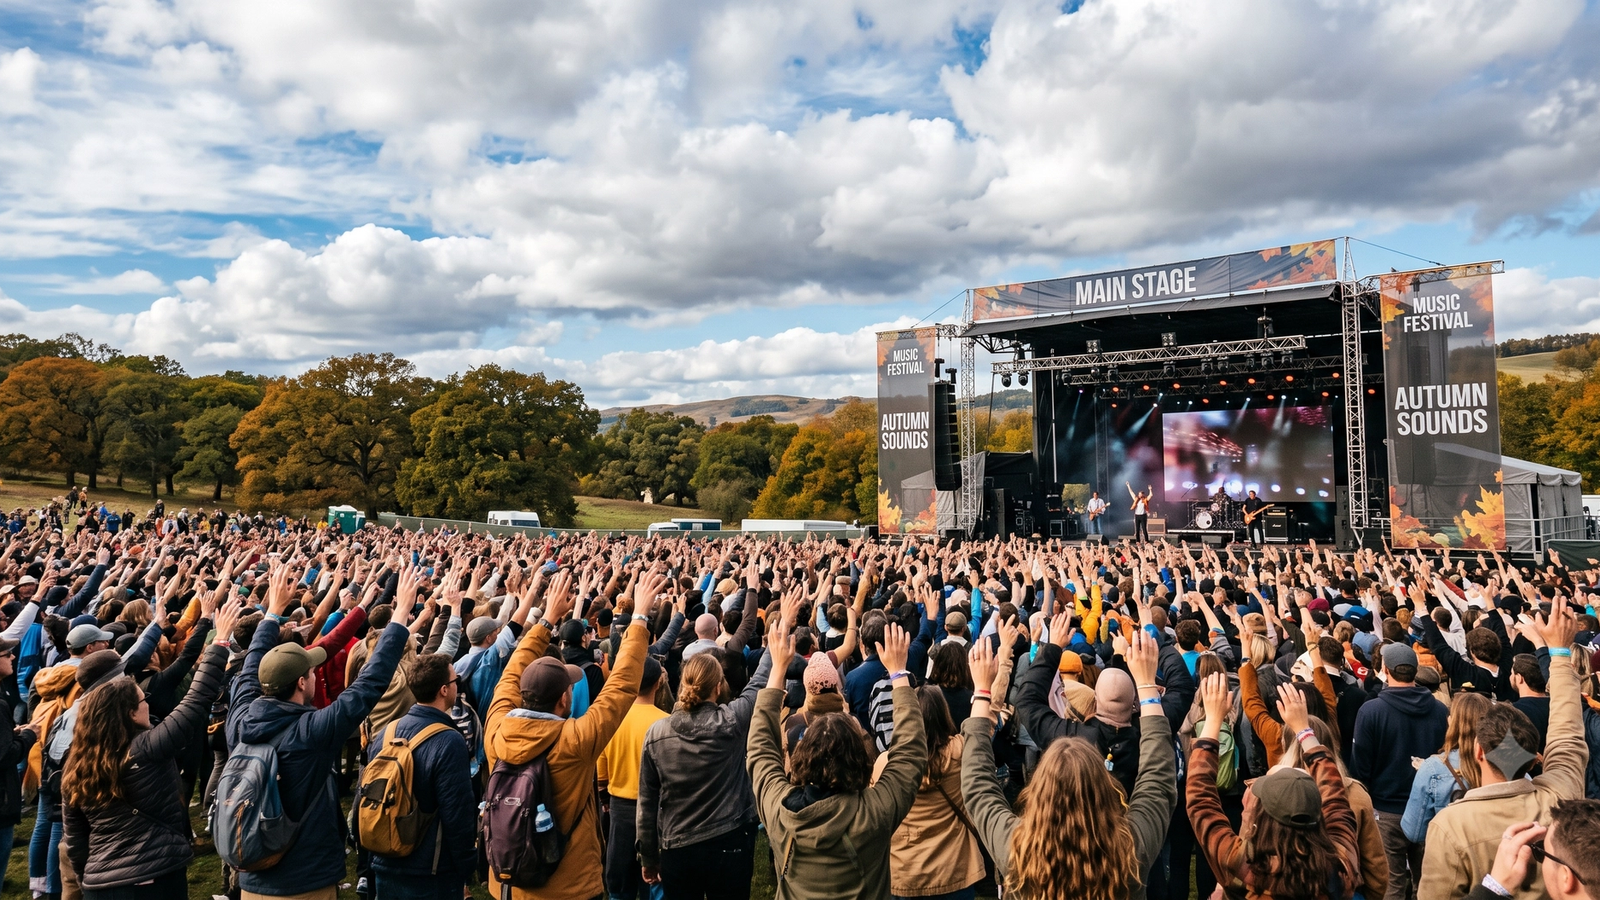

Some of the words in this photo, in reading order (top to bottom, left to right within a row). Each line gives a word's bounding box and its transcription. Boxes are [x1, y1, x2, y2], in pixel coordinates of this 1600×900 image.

[1075, 275, 1126, 306] MAIN
[1131, 266, 1197, 299] STAGE
[1413, 293, 1461, 314] MUSIC
[1403, 311, 1473, 333] FESTIVAL
[893, 348, 918, 362] MUSIC
[887, 361, 924, 375] FESTIVAL
[1394, 382, 1488, 410] AUTUMN
[881, 411, 929, 430] AUTUMN
[1397, 409, 1488, 436] SOUNDS
[881, 431, 928, 449] SOUNDS
